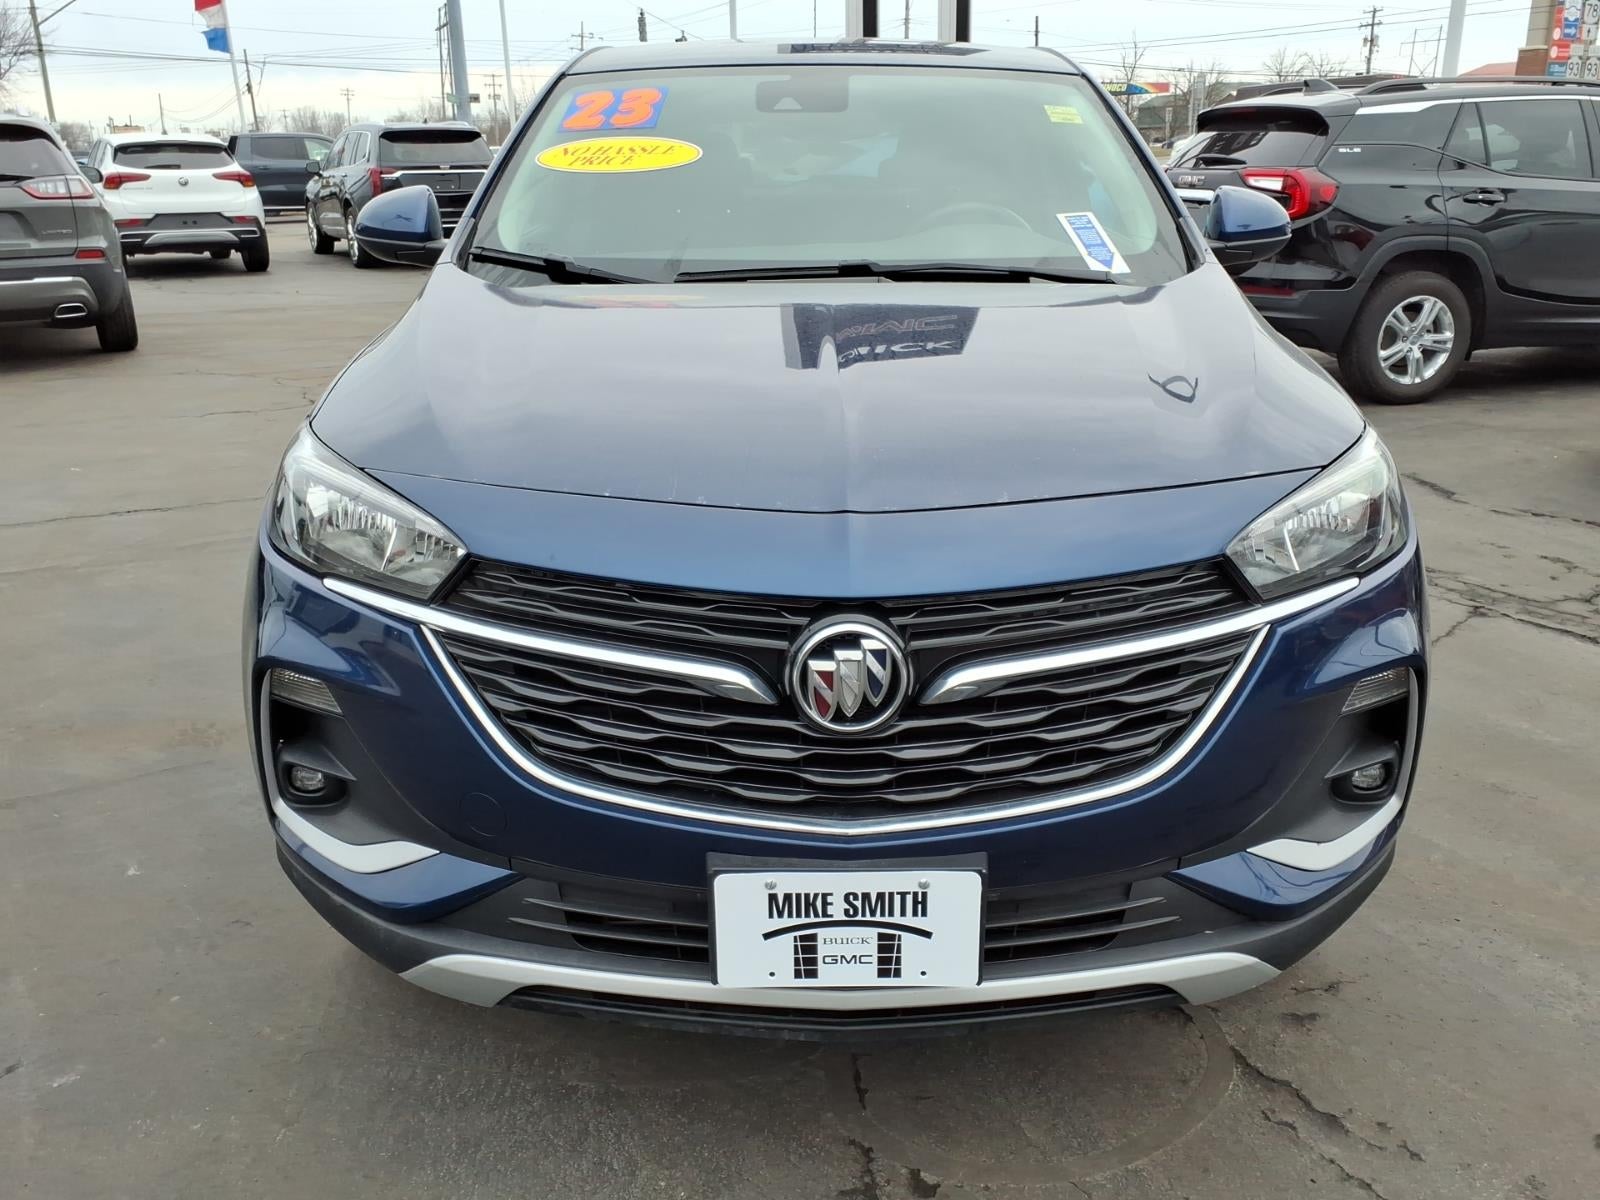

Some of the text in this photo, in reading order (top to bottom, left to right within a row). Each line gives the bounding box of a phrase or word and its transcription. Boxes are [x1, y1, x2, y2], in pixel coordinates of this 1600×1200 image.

[562, 87, 662, 129] 23
[568, 155, 638, 167] PRICE
[767, 891, 929, 919] MIKE SMITH
[823, 937, 874, 945] BUICK
[822, 954, 874, 965] GMC
